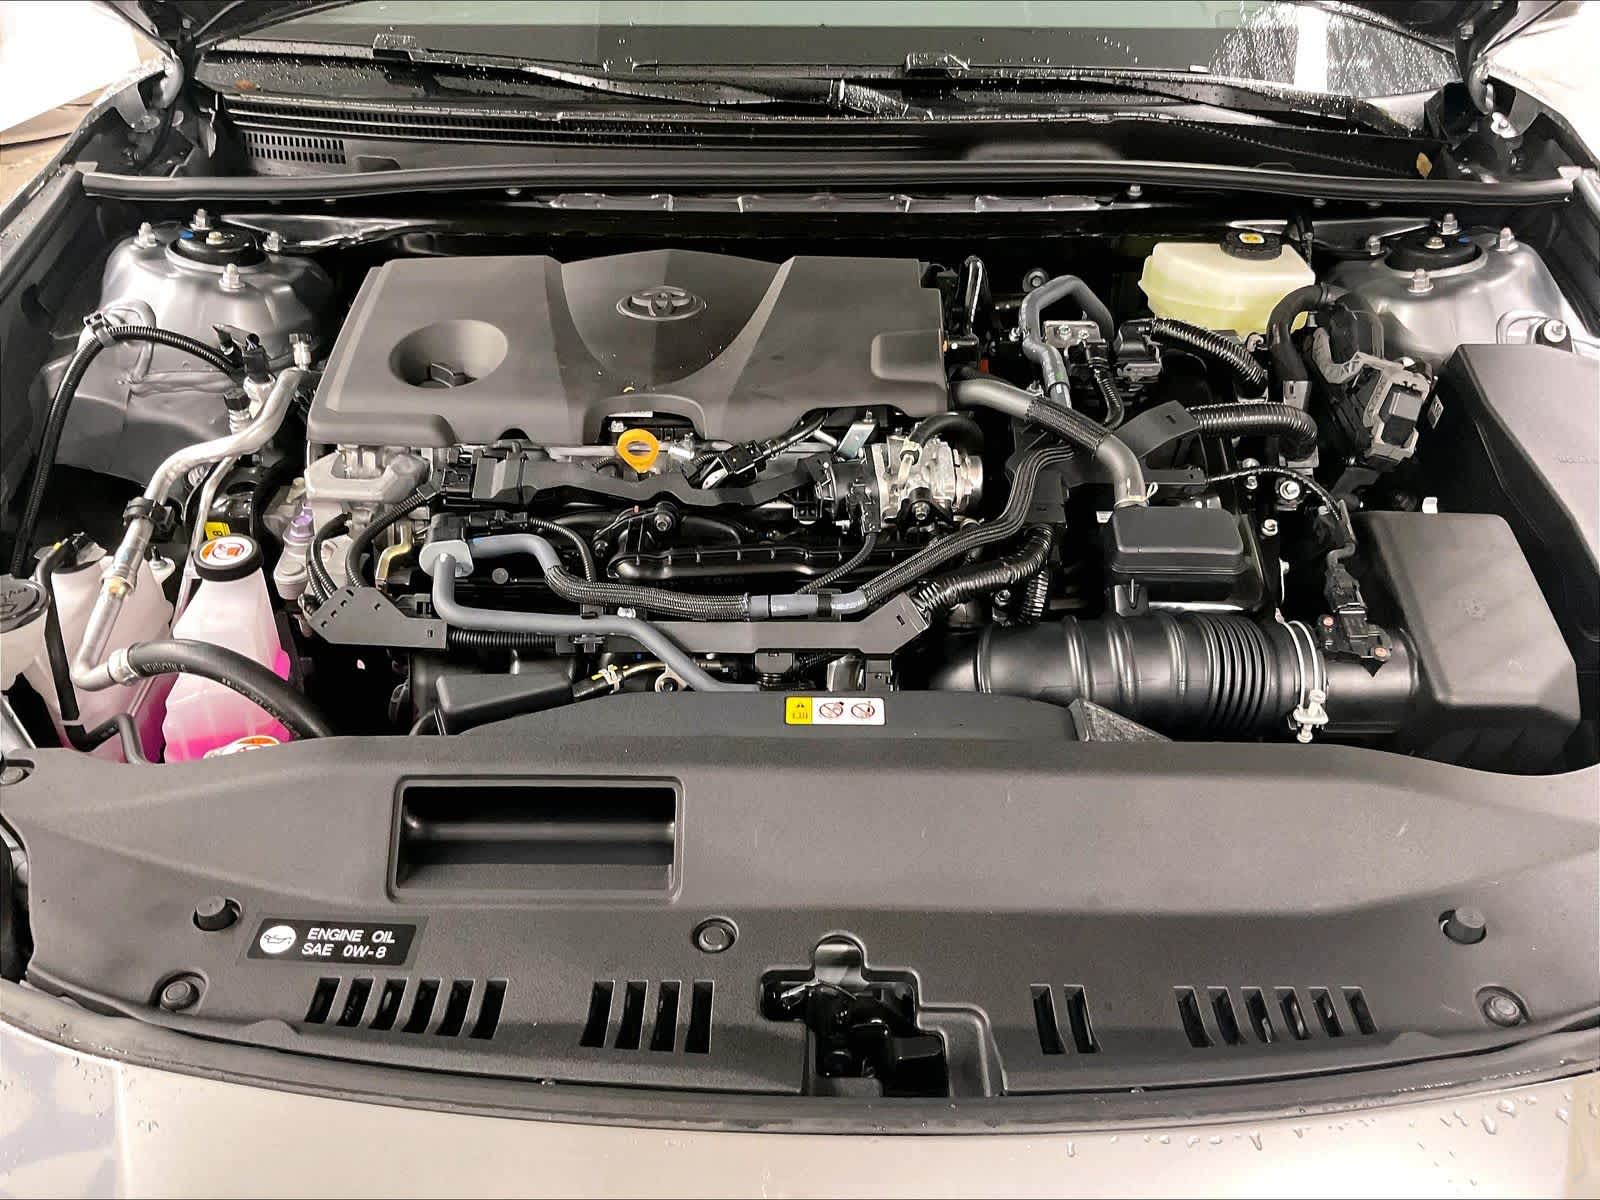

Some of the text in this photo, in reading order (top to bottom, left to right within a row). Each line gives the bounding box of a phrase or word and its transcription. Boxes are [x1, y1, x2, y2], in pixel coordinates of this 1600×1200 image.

[307, 927, 396, 944] ENGINE OIL
[301, 943, 388, 959] SAE 0W-8
